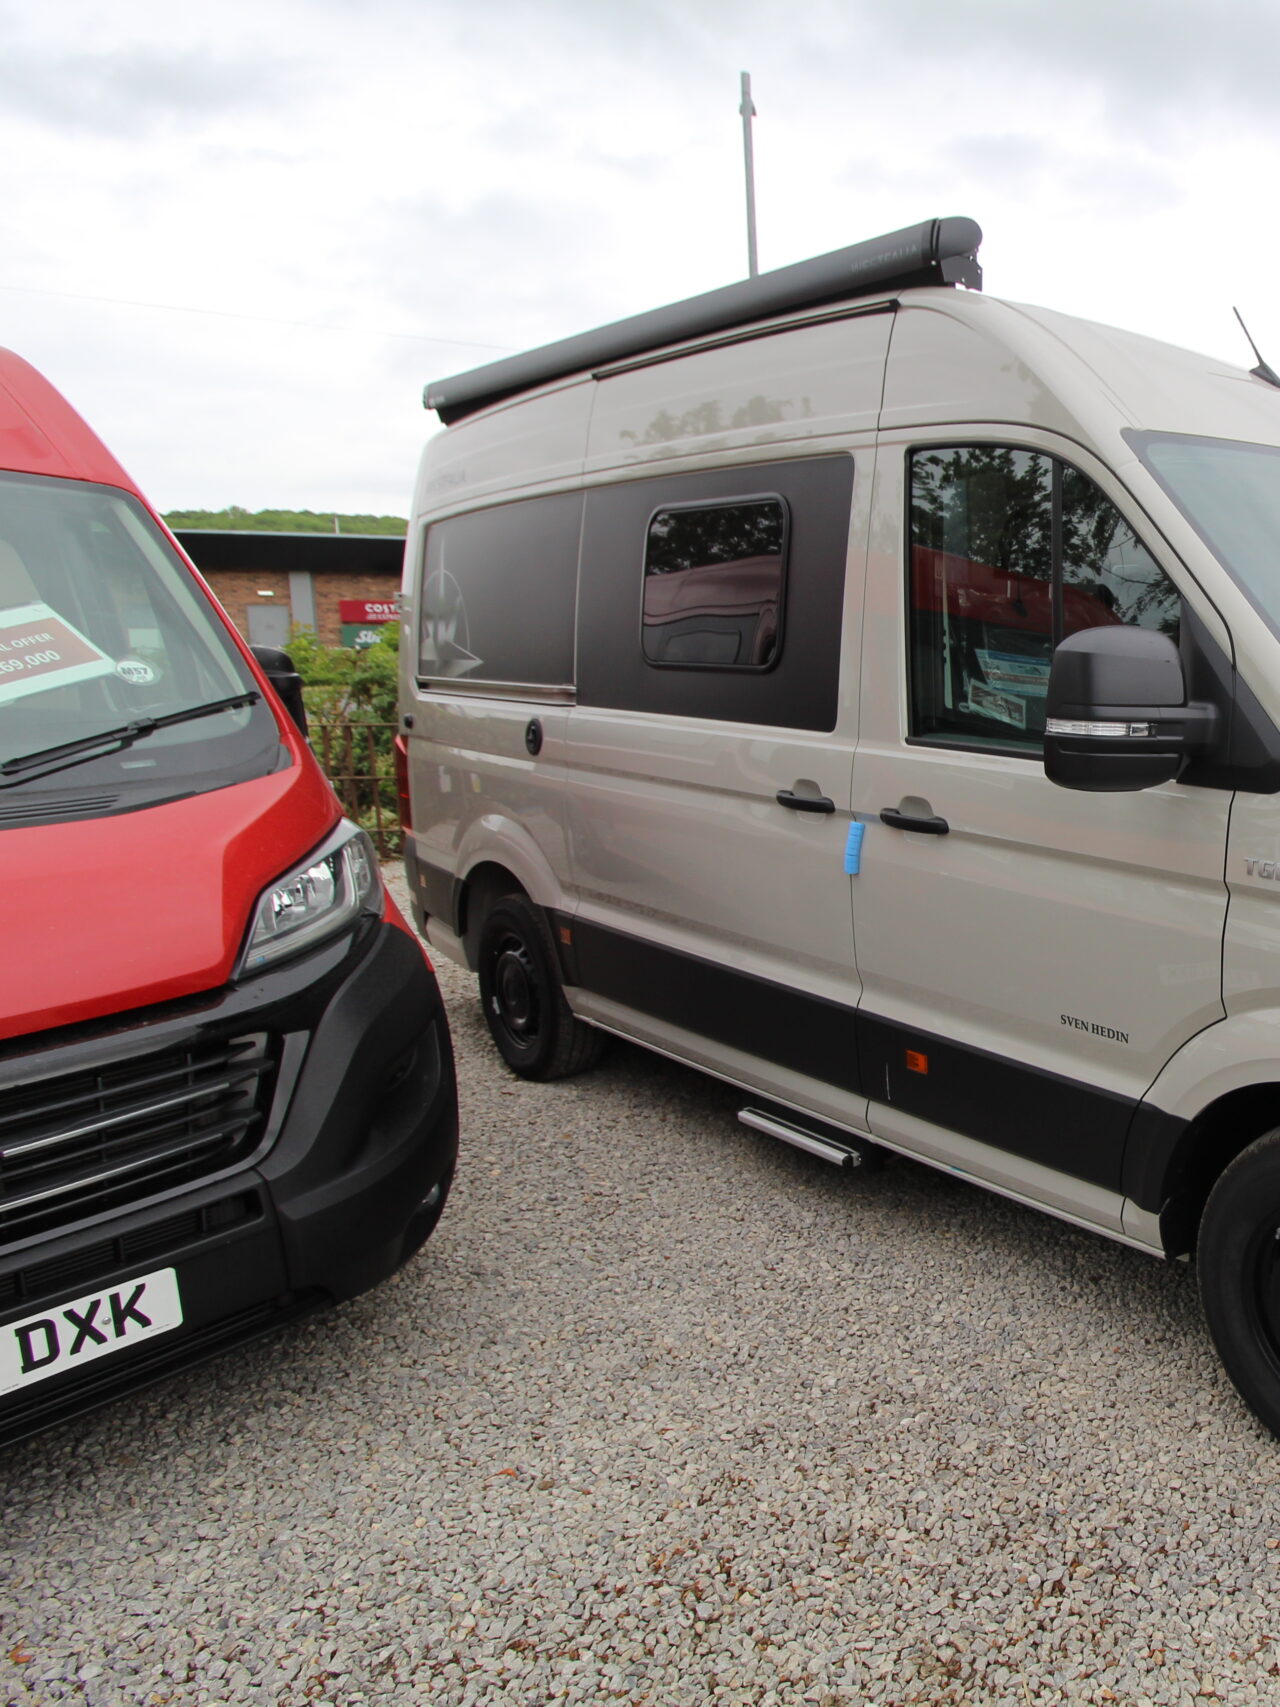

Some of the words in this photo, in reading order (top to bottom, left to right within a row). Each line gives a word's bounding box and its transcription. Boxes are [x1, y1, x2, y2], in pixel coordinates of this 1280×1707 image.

[10, 632, 55, 648] OFFER
[1060, 1014, 1089, 1032] SVEN
[1091, 1022, 1129, 1044] HEDIN
[14, 1282, 152, 1374] DXK
